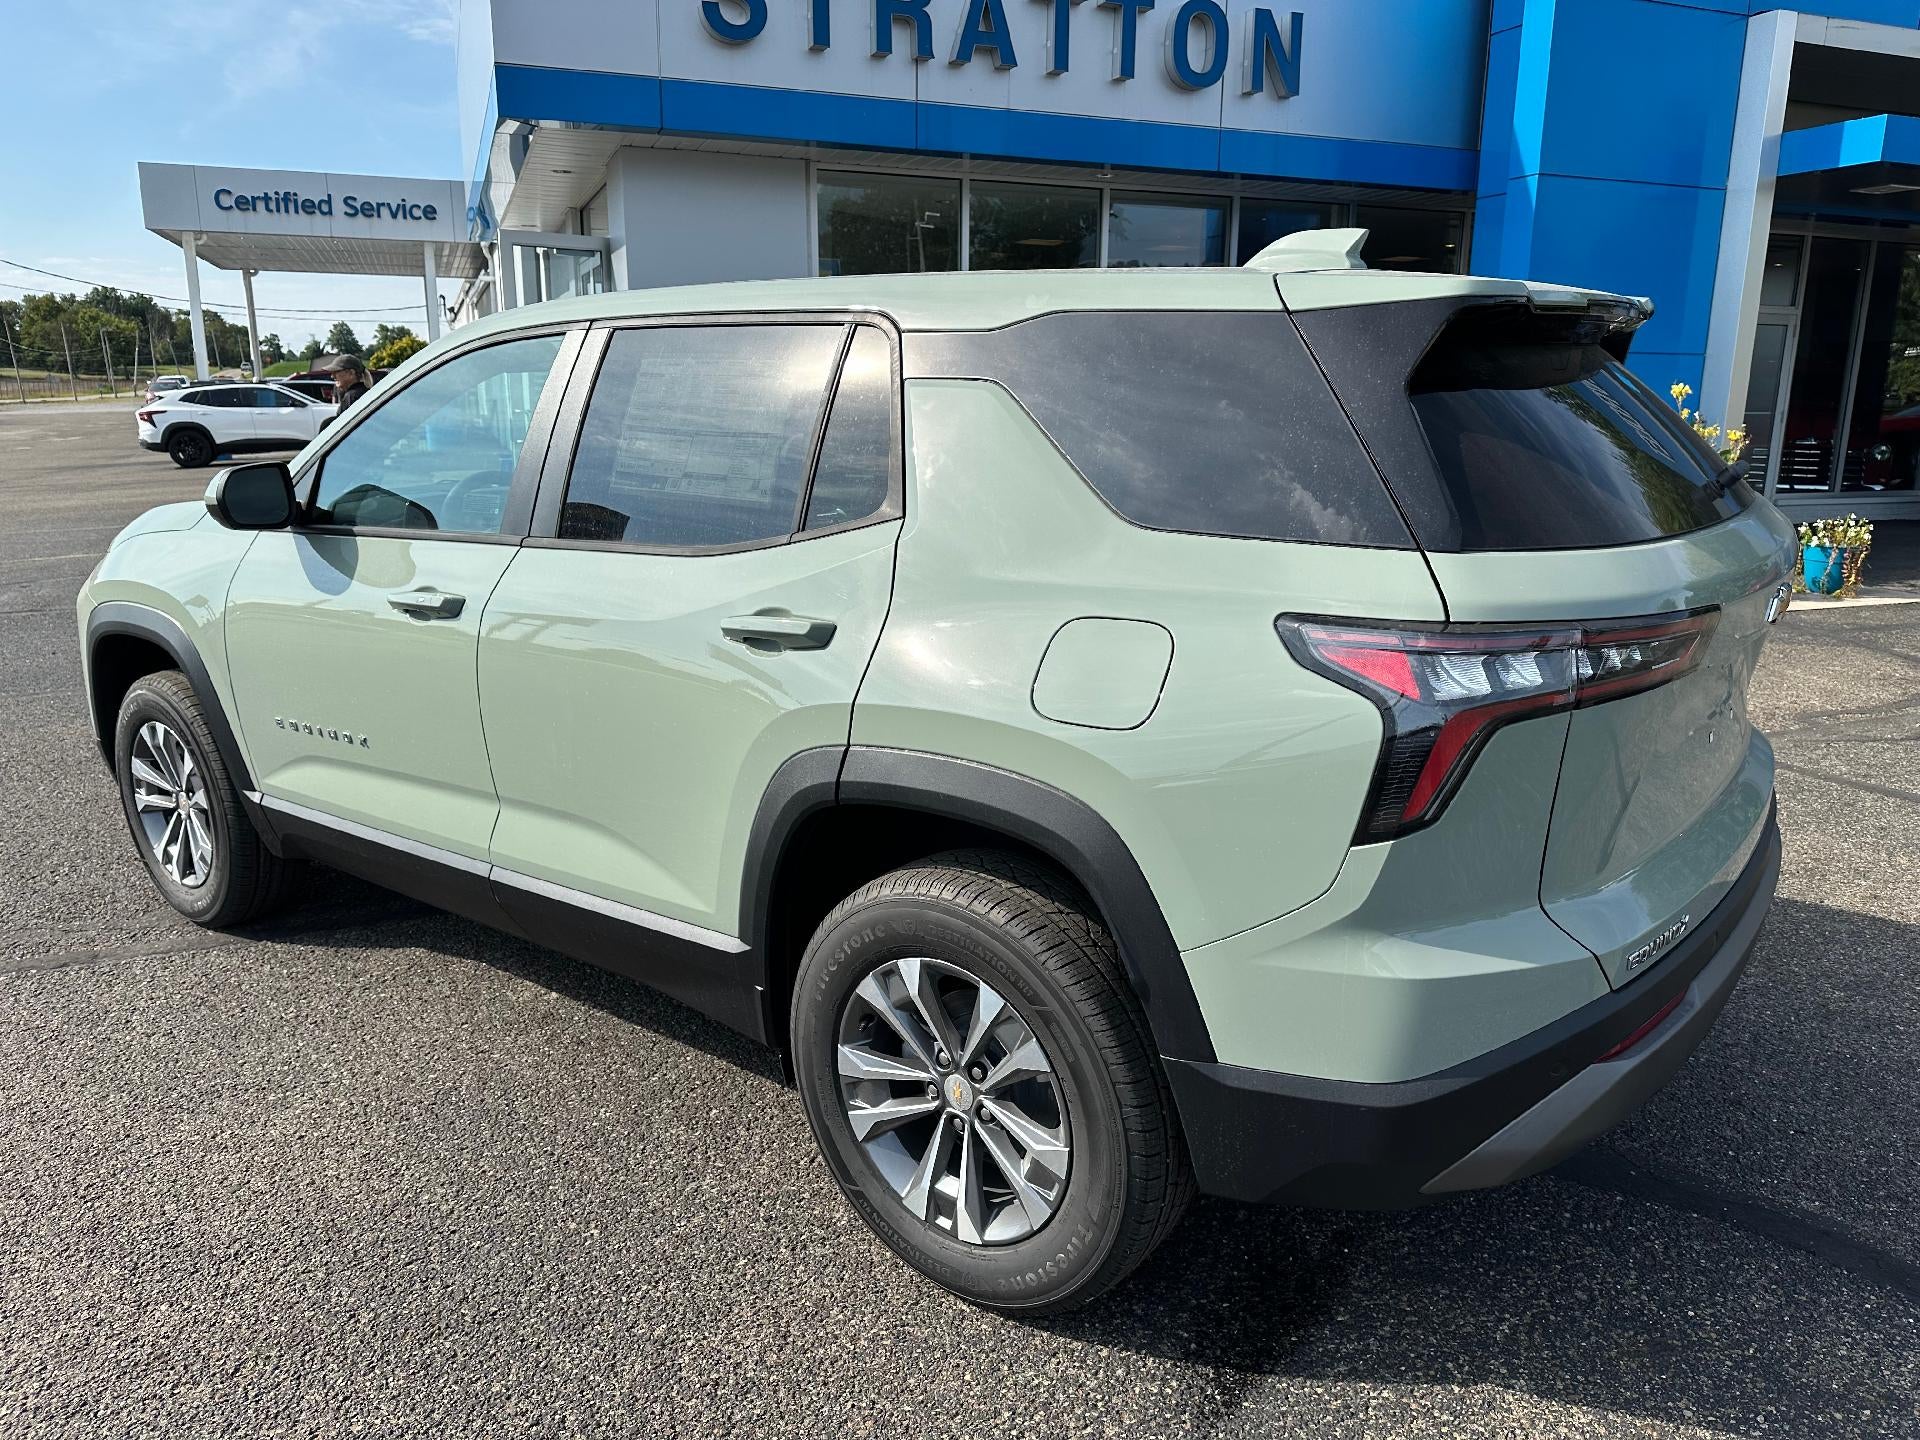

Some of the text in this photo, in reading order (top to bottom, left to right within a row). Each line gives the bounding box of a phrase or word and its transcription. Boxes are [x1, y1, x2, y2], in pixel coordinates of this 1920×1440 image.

[214, 188, 438, 221] Certified Service
[274, 716, 370, 749] EQUINOX
[1625, 913, 1690, 971] EQUINOX
